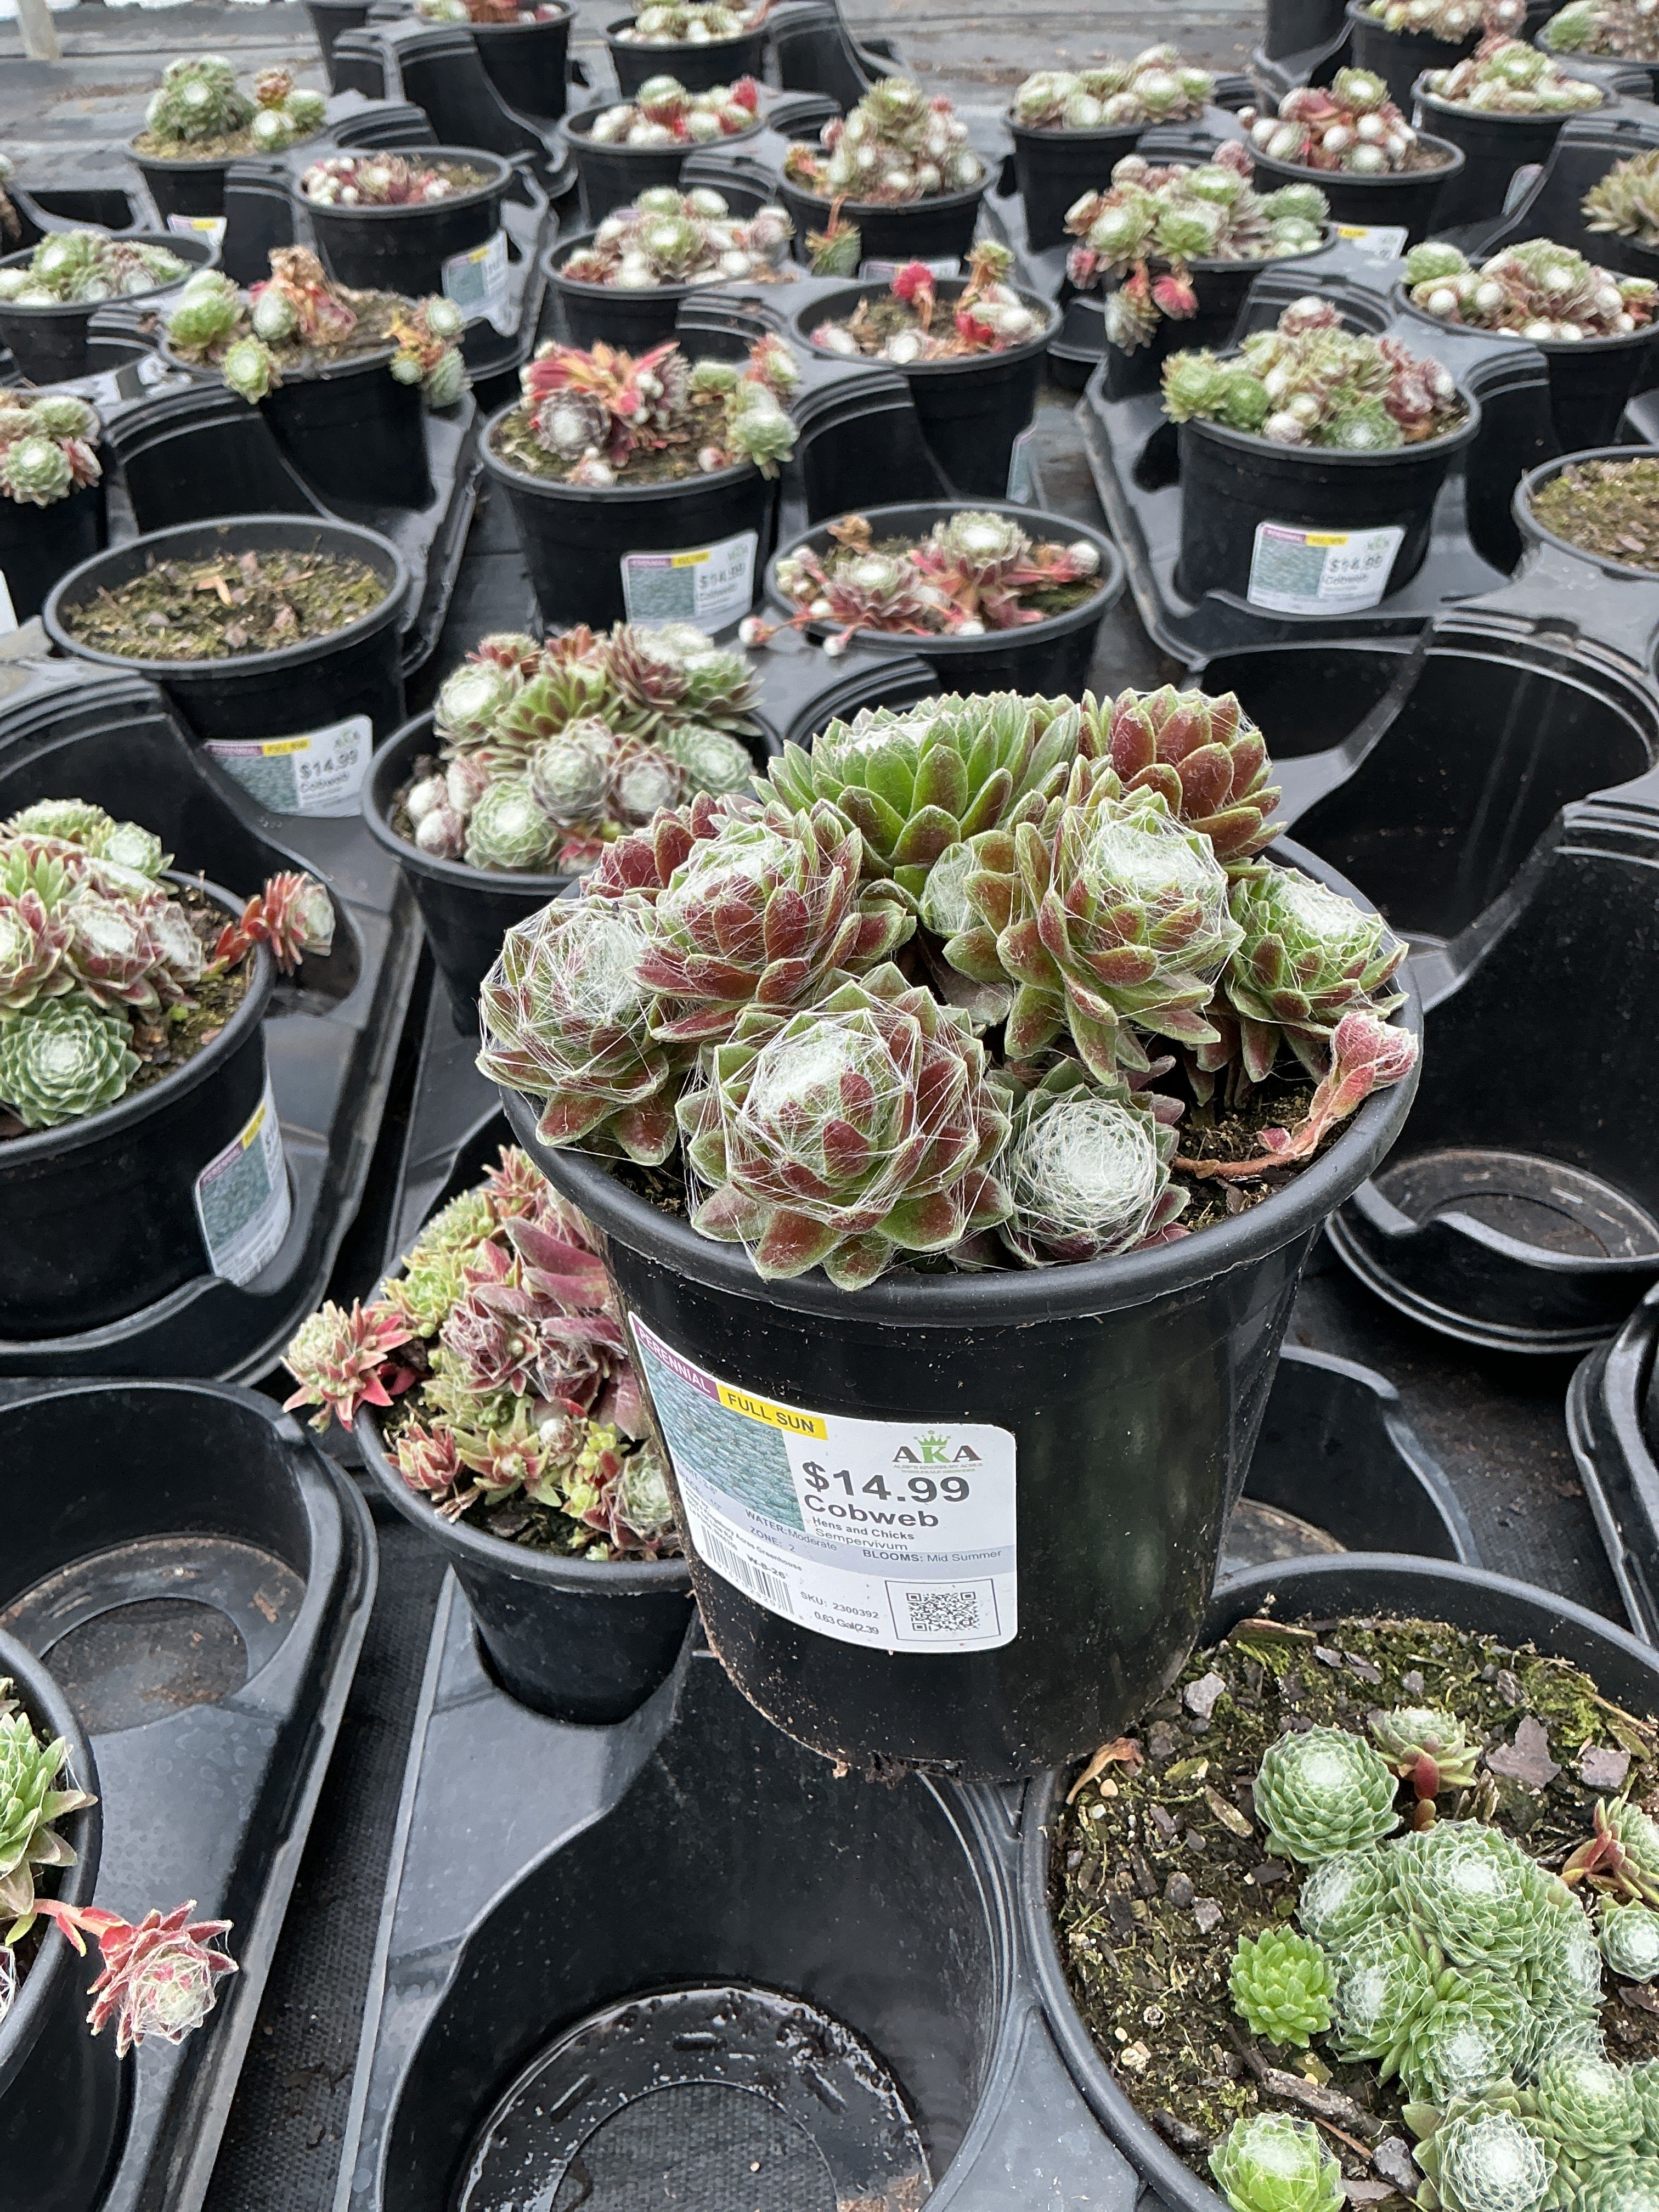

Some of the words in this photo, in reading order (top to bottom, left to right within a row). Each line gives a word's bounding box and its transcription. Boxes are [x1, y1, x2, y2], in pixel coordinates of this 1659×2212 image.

[639, 1327, 710, 1393] PERENNIAL
[727, 1392, 772, 1421] FULL
[776, 1412, 814, 1433] SUN
[892, 1445, 982, 1464] AKA
[802, 1461, 969, 1503] $14.99
[804, 1494, 939, 1527] Cobweb
[745, 1509, 787, 1535] WATER:
[788, 1528, 837, 1551] Moderate
[749, 1525, 782, 1548] ZONE:
[788, 1544, 795, 1553] 2
[812, 1516, 842, 1531] Hens
[846, 1526, 868, 1536] and
[872, 1529, 915, 1540] Chicks
[815, 1528, 908, 1551] Sempervivum
[736, 1533, 755, 1550] Acres
[756, 1546, 803, 1571] Greenhouse
[863, 1549, 923, 1562] BLOOMS:
[952, 1549, 1001, 1561] Summer
[800, 1591, 827, 1607] SKU:
[833, 1602, 879, 1619] 2300392
[814, 1611, 836, 1624] 0.63
